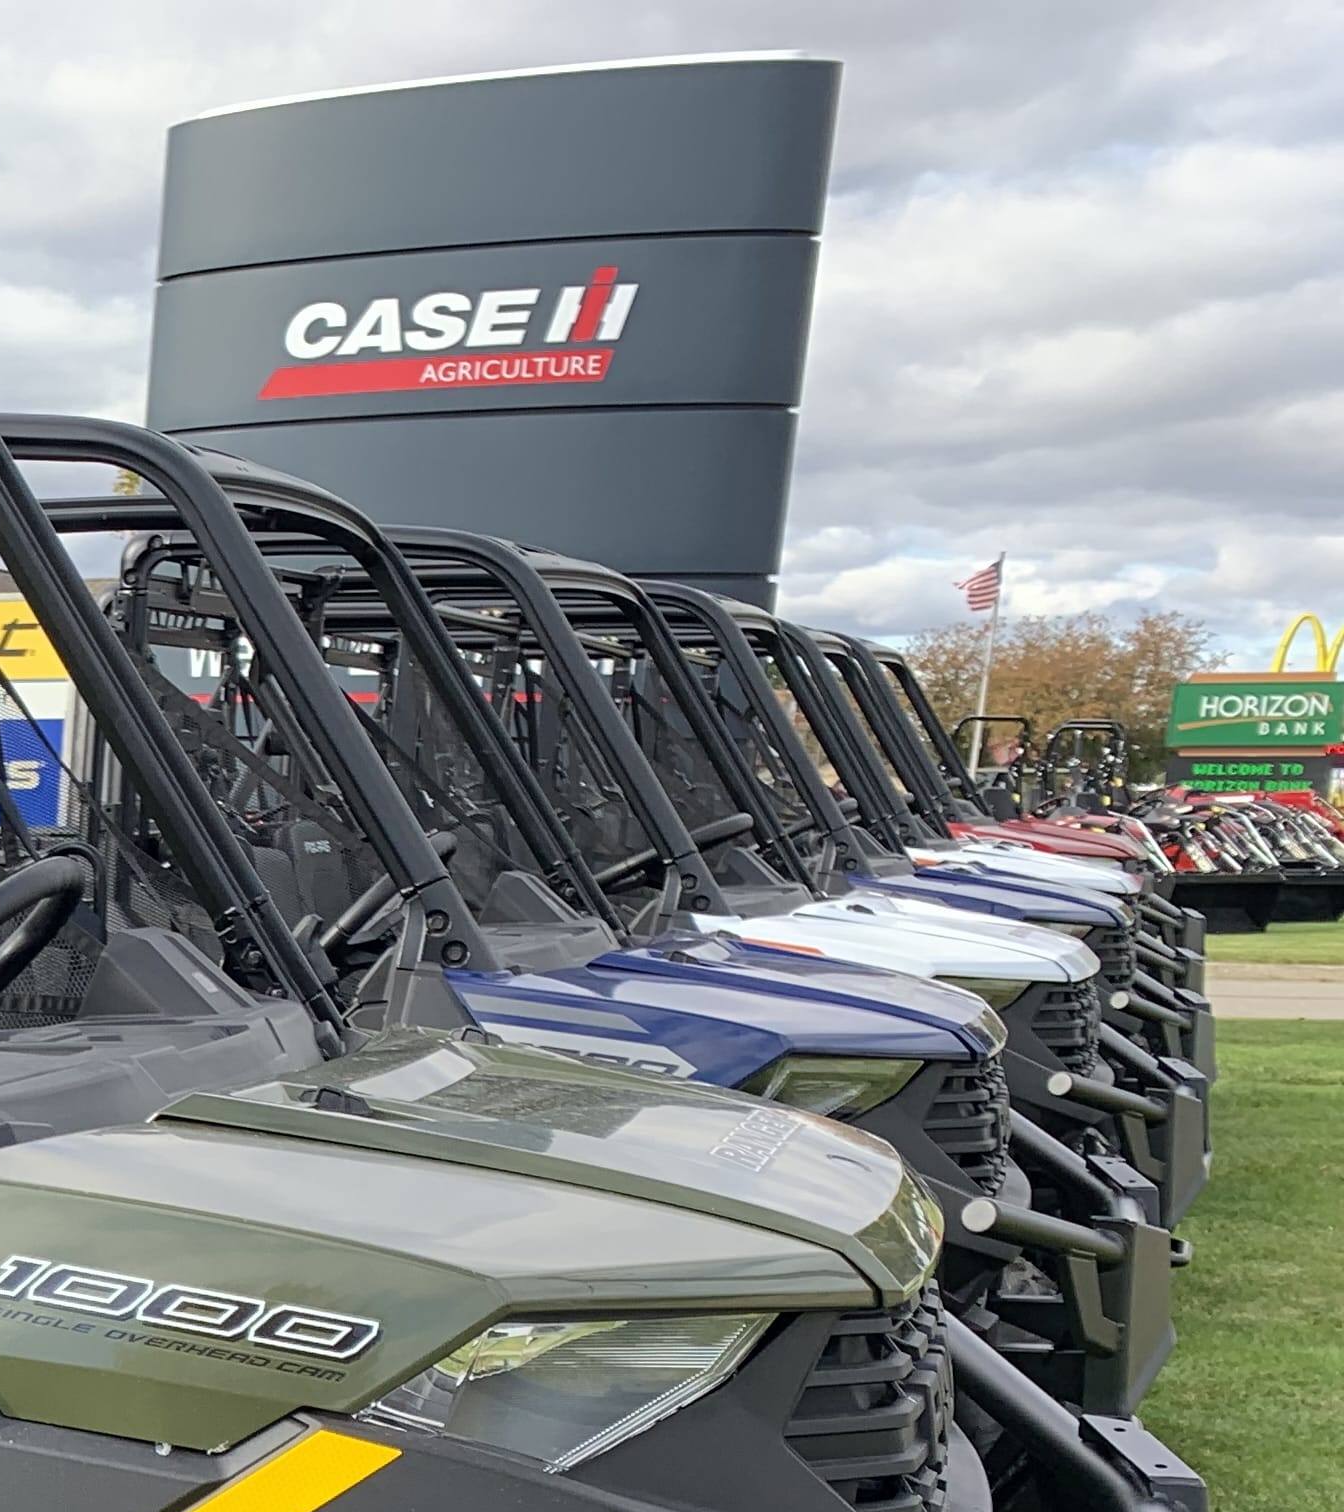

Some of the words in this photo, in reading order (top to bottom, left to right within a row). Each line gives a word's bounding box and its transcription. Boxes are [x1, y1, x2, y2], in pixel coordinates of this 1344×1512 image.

[283, 288, 540, 358] CASE
[418, 355, 602, 384] AGRICULTURE
[1199, 694, 1331, 718] HORIZON
[1257, 721, 1326, 736] BANK
[1191, 763, 1274, 776] WELCOME
[1280, 763, 1305, 776] TO
[103, 1328, 270, 1367] OVERHEAD
[272, 1360, 348, 1384] CAM
